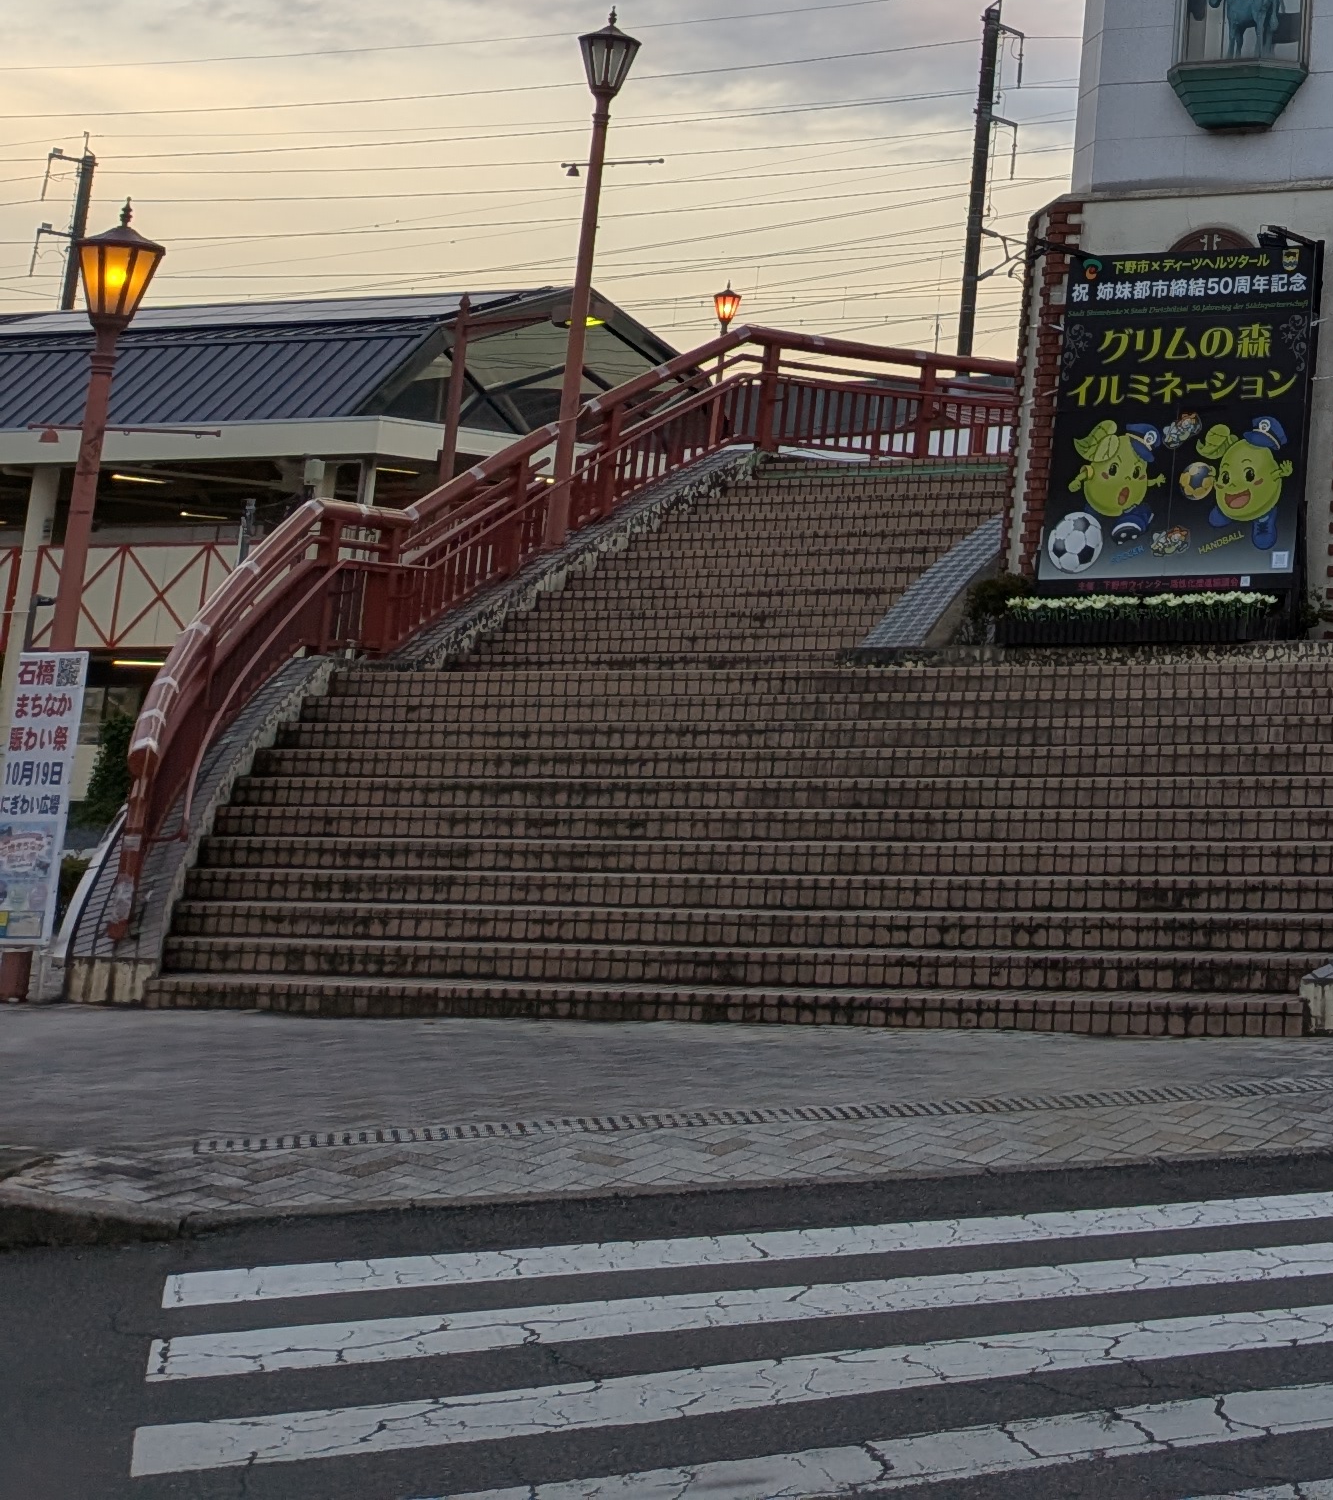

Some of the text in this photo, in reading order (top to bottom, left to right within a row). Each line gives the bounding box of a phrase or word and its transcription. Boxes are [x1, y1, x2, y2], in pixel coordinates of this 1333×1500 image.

[1071, 273, 1307, 302] 祝 姉妹都市締結50周年記念
[1099, 323, 1274, 365] グリムの森
[1065, 370, 1298, 407] イルミネーション
[1198, 531, 1245, 555] HANDBALL
[18, 660, 56, 686] 石橋
[15, 693, 72, 719] まちなか
[5, 761, 63, 786] 10月19日
[0, 794, 60, 815] にぎわい広場
